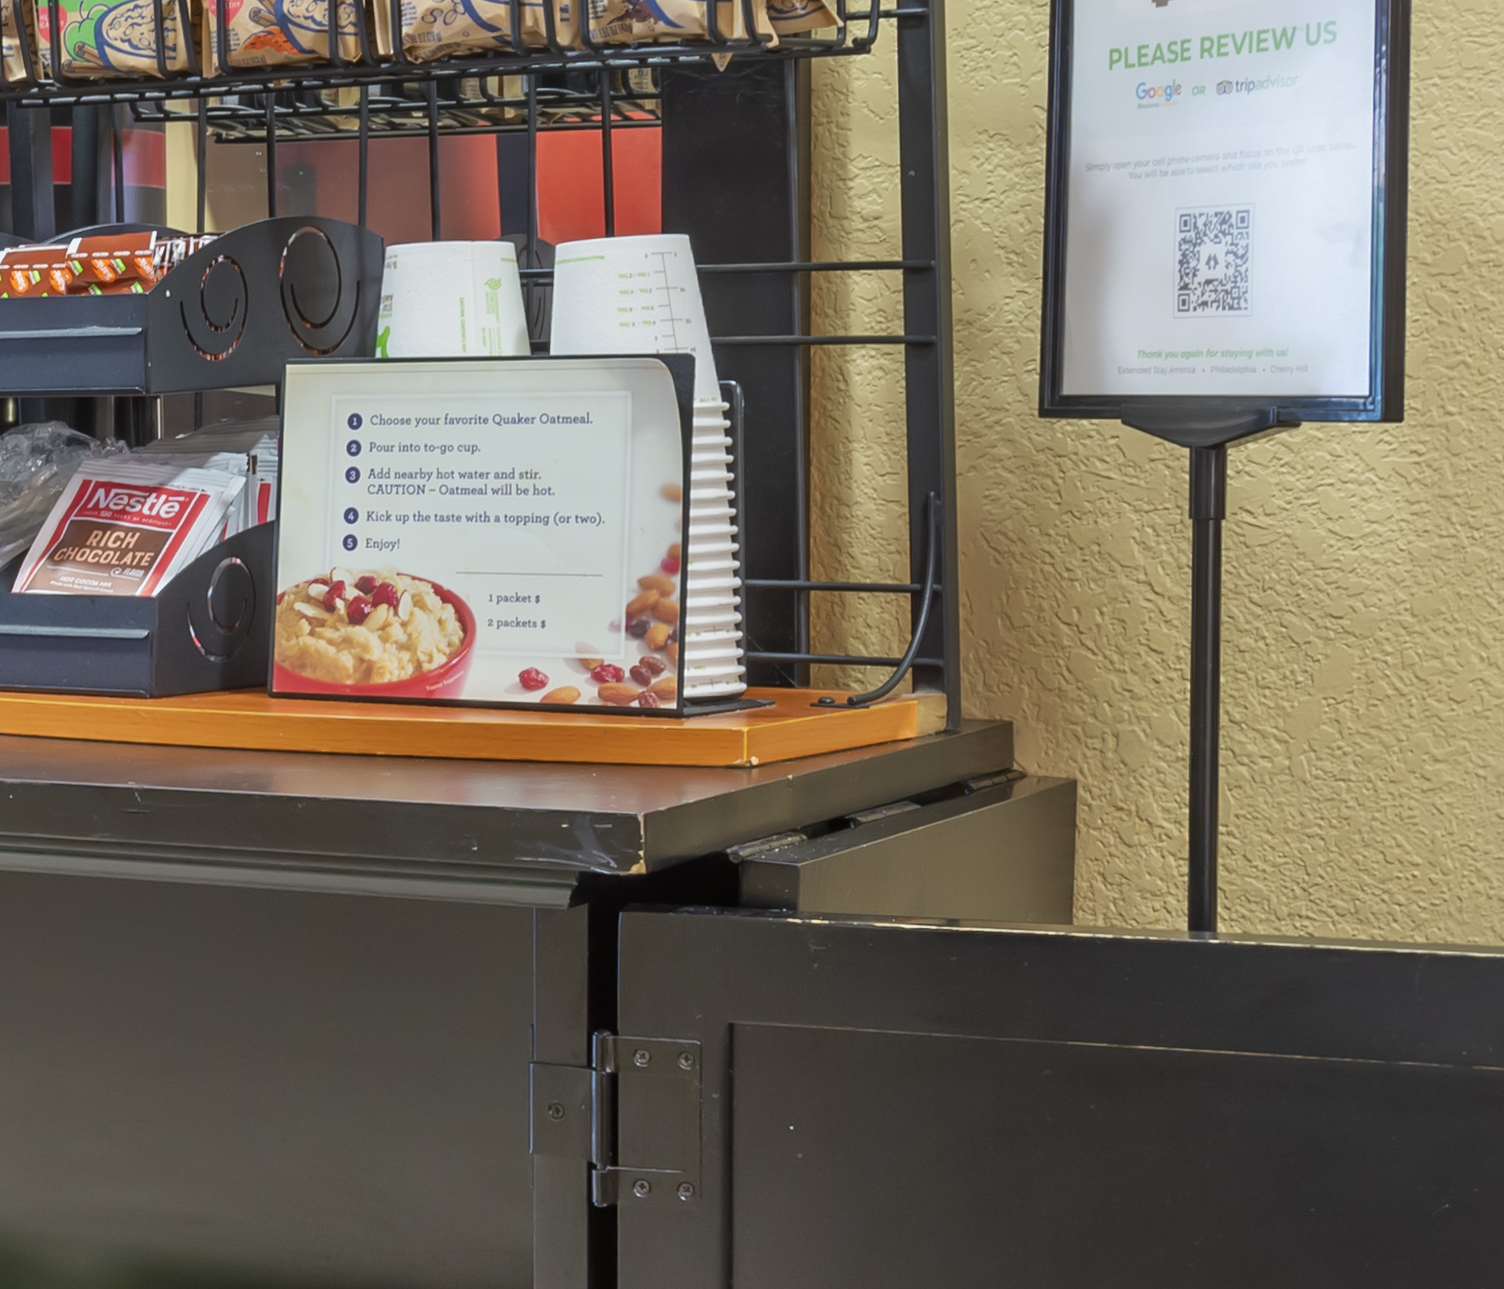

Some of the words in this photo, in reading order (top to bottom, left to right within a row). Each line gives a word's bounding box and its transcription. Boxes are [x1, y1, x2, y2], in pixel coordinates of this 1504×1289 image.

[1109, 38, 1192, 71] PLEASE
[1199, 26, 1297, 59] REVIEW
[1305, 20, 1338, 46] US
[1136, 79, 1182, 102] Google
[1192, 85, 1206, 96] OR
[1235, 74, 1298, 95] tripadvisor
[1137, 349, 1163, 359] Thank
[1164, 351, 1178, 360] you
[1180, 348, 1203, 360] again
[1206, 348, 1219, 359] for
[1220, 347, 1254, 360] staying
[1255, 347, 1274, 357] with
[369, 414, 412, 426] Choose
[414, 416, 441, 428] your
[444, 413, 489, 426] favorite
[492, 413, 537, 427] Quaker
[539, 411, 594, 425] Oatmeal.
[368, 441, 395, 453] Pour
[398, 441, 421, 453] into
[424, 442, 455, 455] to-go
[457, 443, 481, 455] cup.
[367, 468, 391, 480] Add
[394, 468, 433, 482] nearby
[436, 468, 454, 480] hot
[458, 470, 490, 480] water
[493, 467, 515, 480] and
[518, 469, 542, 480] stir.
[367, 484, 426, 496] CAUTION
[438, 483, 488, 496] Oatmeal
[491, 483, 512, 496] will
[515, 483, 530, 496] be
[532, 483, 555, 496] hot.
[87, 488, 186, 519] Nestlé
[366, 510, 392, 522] Kick
[395, 513, 410, 524] up
[412, 511, 432, 522] the
[434, 512, 462, 523] taste
[465, 511, 491, 523] with
[494, 515, 501, 523] a
[504, 512, 550, 526] topping
[553, 511, 572, 526] (or
[575, 511, 605, 527] two).
[86, 529, 141, 548] RICH
[365, 538, 401, 551] Enjoy!
[53, 546, 155, 567] CHOCOLATE
[488, 594, 493, 603] 1
[496, 591, 532, 605] packet
[534, 594, 541, 604] $
[487, 619, 494, 627] 2
[496, 616, 538, 630] packets
[540, 619, 547, 629] $
